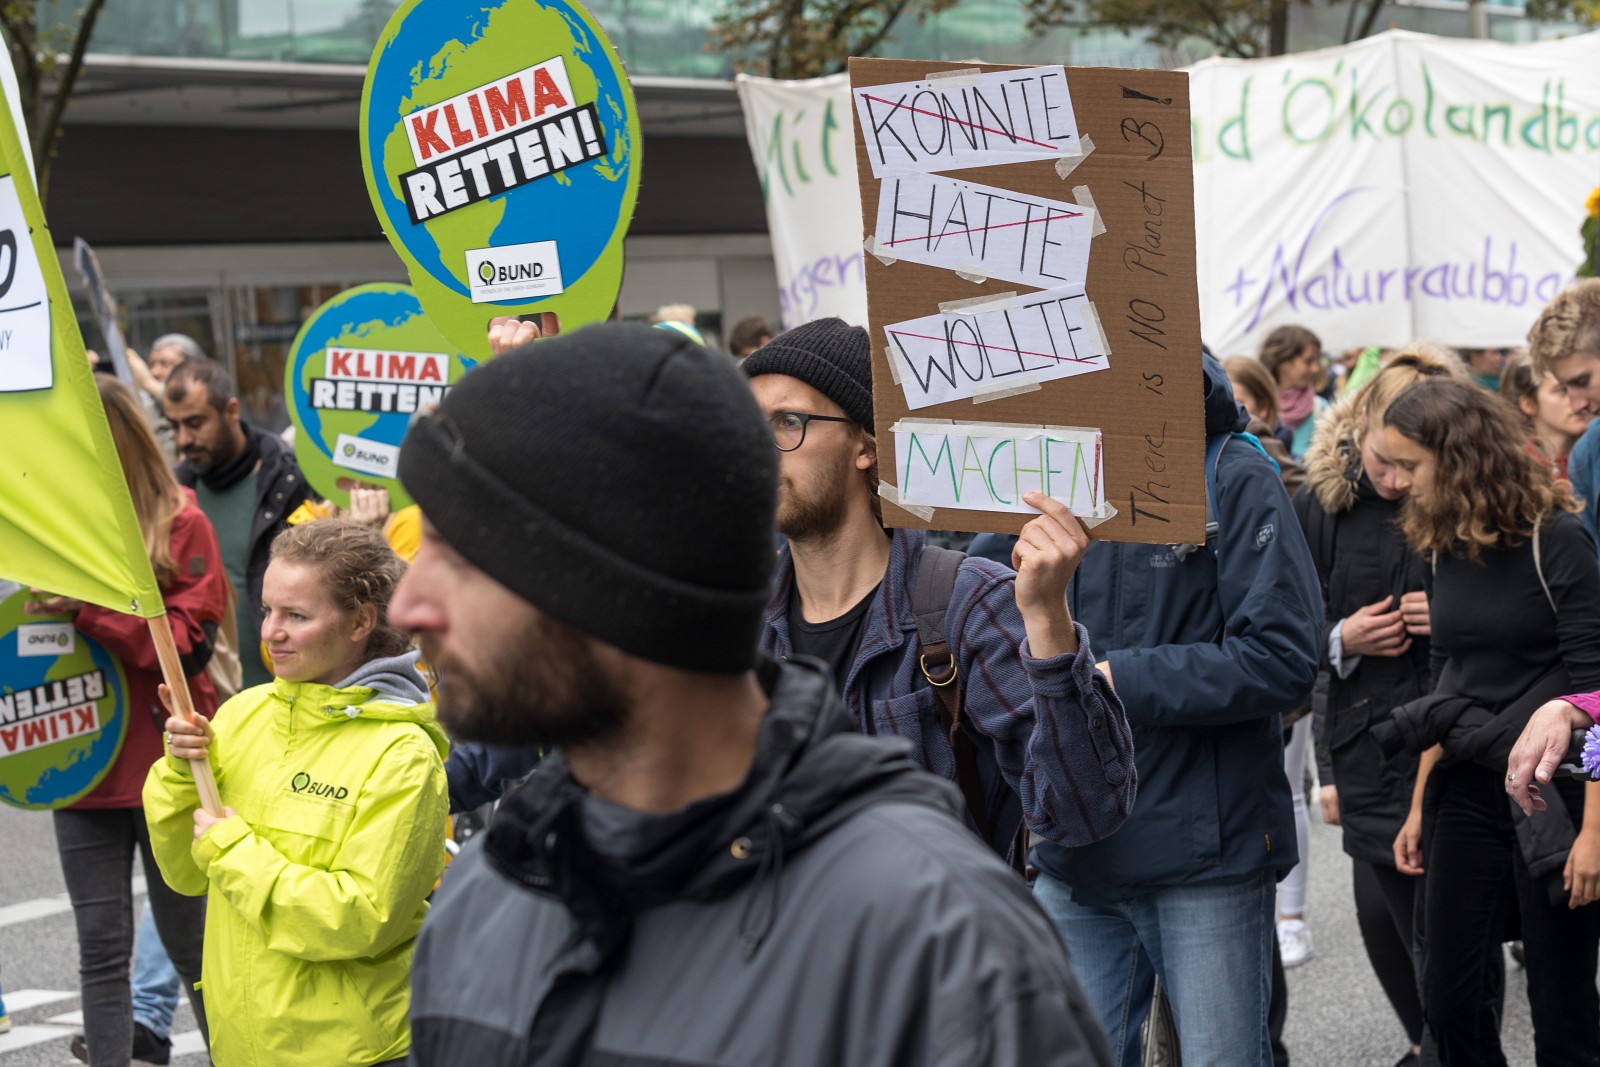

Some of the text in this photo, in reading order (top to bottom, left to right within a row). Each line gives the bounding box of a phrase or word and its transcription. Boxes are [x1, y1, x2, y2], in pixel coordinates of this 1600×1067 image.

[411, 67, 568, 160] KLIMA
[863, 73, 1071, 165] KÖNNTE
[1191, 74, 1254, 164] d
[407, 109, 601, 220] RETTEN!
[498, 263, 543, 281] BUND
[890, 179, 1078, 281] HÄTTE
[1122, 180, 1169, 277] Planet
[331, 352, 442, 381] KLIMA
[890, 294, 1103, 394] WOLLTE
[1128, 298, 1168, 350] NO
[1138, 371, 1164, 396] is
[1129, 421, 1171, 526] There
[0, 705, 97, 752] KLIMA
[307, 782, 348, 799] BUND
